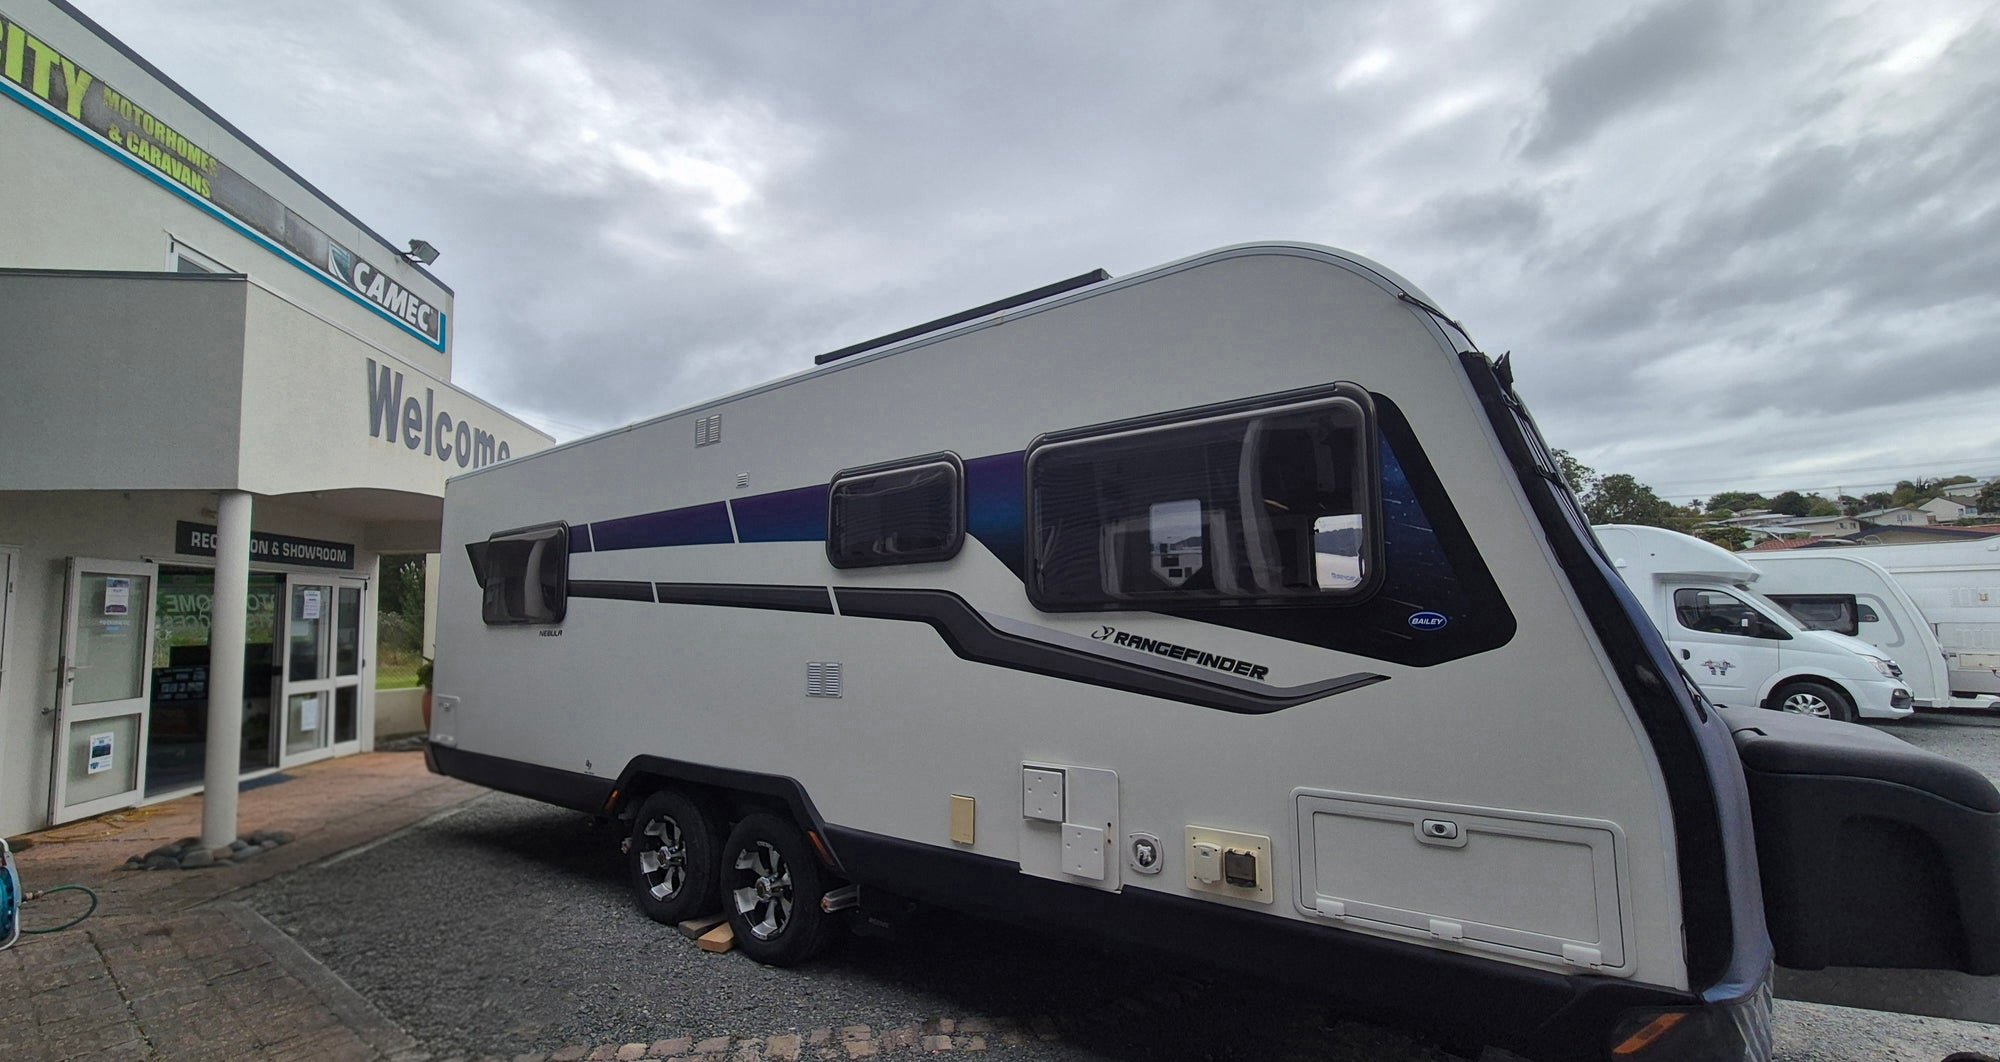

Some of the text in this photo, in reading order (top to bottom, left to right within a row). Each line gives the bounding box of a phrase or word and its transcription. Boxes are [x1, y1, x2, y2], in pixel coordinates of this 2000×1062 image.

[103, 85, 218, 177] MOTORHOMES
[108, 124, 212, 199] & CARAVANS
[354, 262, 431, 331] CAMEC
[191, 531, 347, 563] RECON & SHOWROOM
[539, 629, 563, 638] NEBULA
[1411, 617, 1443, 626] BAILEY
[1113, 631, 1270, 681] RANGEFINDER
